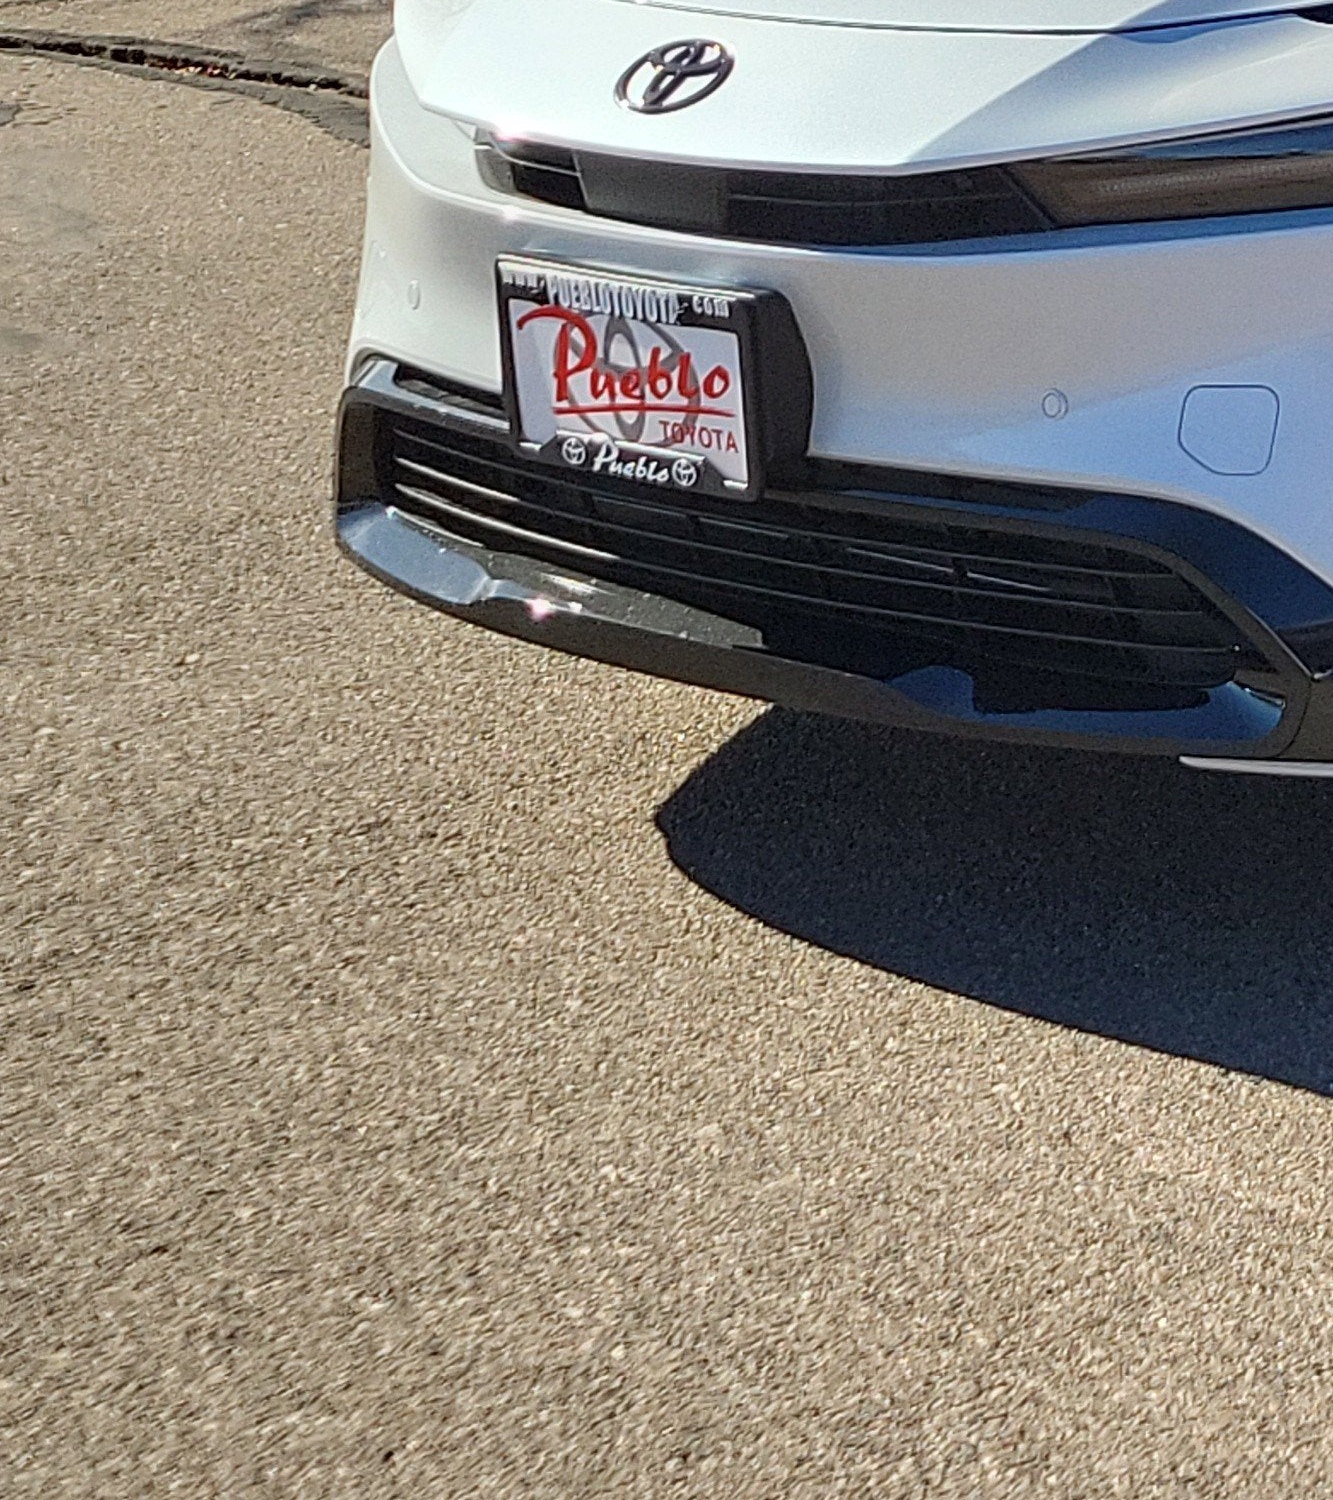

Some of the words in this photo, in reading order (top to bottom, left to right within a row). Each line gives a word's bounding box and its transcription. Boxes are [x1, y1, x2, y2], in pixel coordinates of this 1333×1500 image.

[516, 304, 730, 402] Pueblo
[591, 434, 670, 482] Pueblo
[659, 420, 739, 454] TOYOTA
